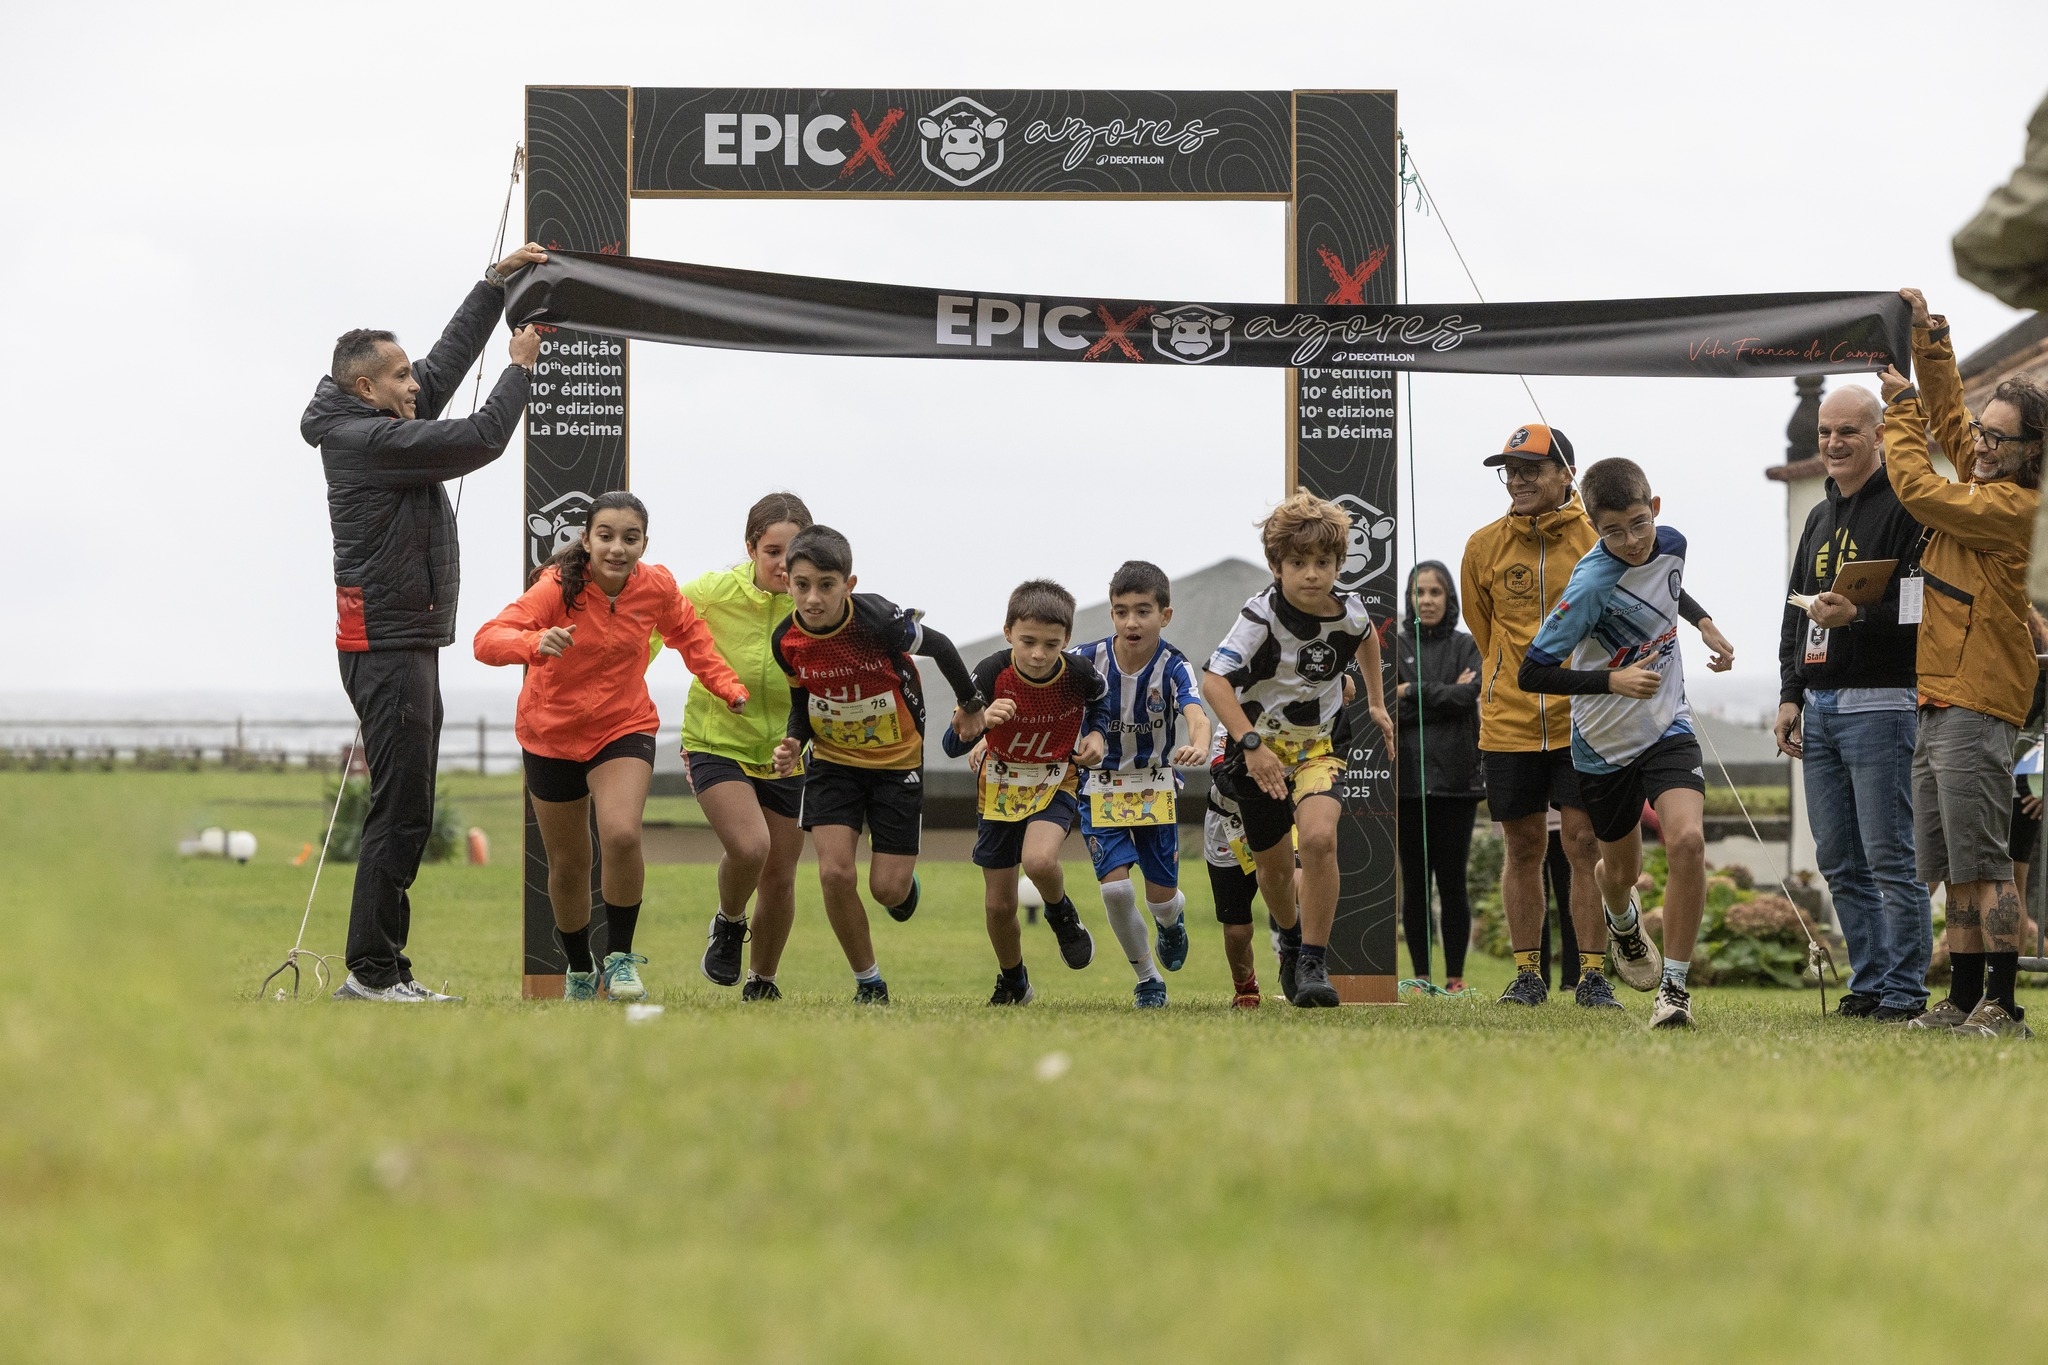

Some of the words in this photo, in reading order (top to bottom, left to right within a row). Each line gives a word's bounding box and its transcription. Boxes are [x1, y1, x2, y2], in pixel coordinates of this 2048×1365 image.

[1024, 116, 1220, 171] azores
[1110, 156, 1164, 164] DECATHLON
[1244, 313, 1481, 366] azores
[1349, 353, 1415, 361] DECATHLON
[1688, 337, 1729, 361] Vila
[1731, 337, 1800, 361] Franca
[1803, 339, 1824, 359] do
[1829, 341, 1889, 367] Campo
[561, 382, 622, 396] édition
[1331, 385, 1392, 399] édition
[556, 402, 624, 415] edizione
[1327, 405, 1394, 418] edizione
[530, 422, 551, 436] La
[556, 421, 622, 436] Décima
[1302, 425, 1322, 439] La
[1327, 424, 1393, 439] Décima
[1807, 652, 1826, 661] Staff
[812, 666, 853, 679] health
[871, 698, 887, 710] 78
[1013, 714, 1054, 724] health
[1110, 718, 1164, 734] BETANO
[1008, 731, 1052, 758] HL
[1047, 766, 1061, 777] 76
[1150, 771, 1165, 782] 74
[1343, 786, 1370, 798] 025
